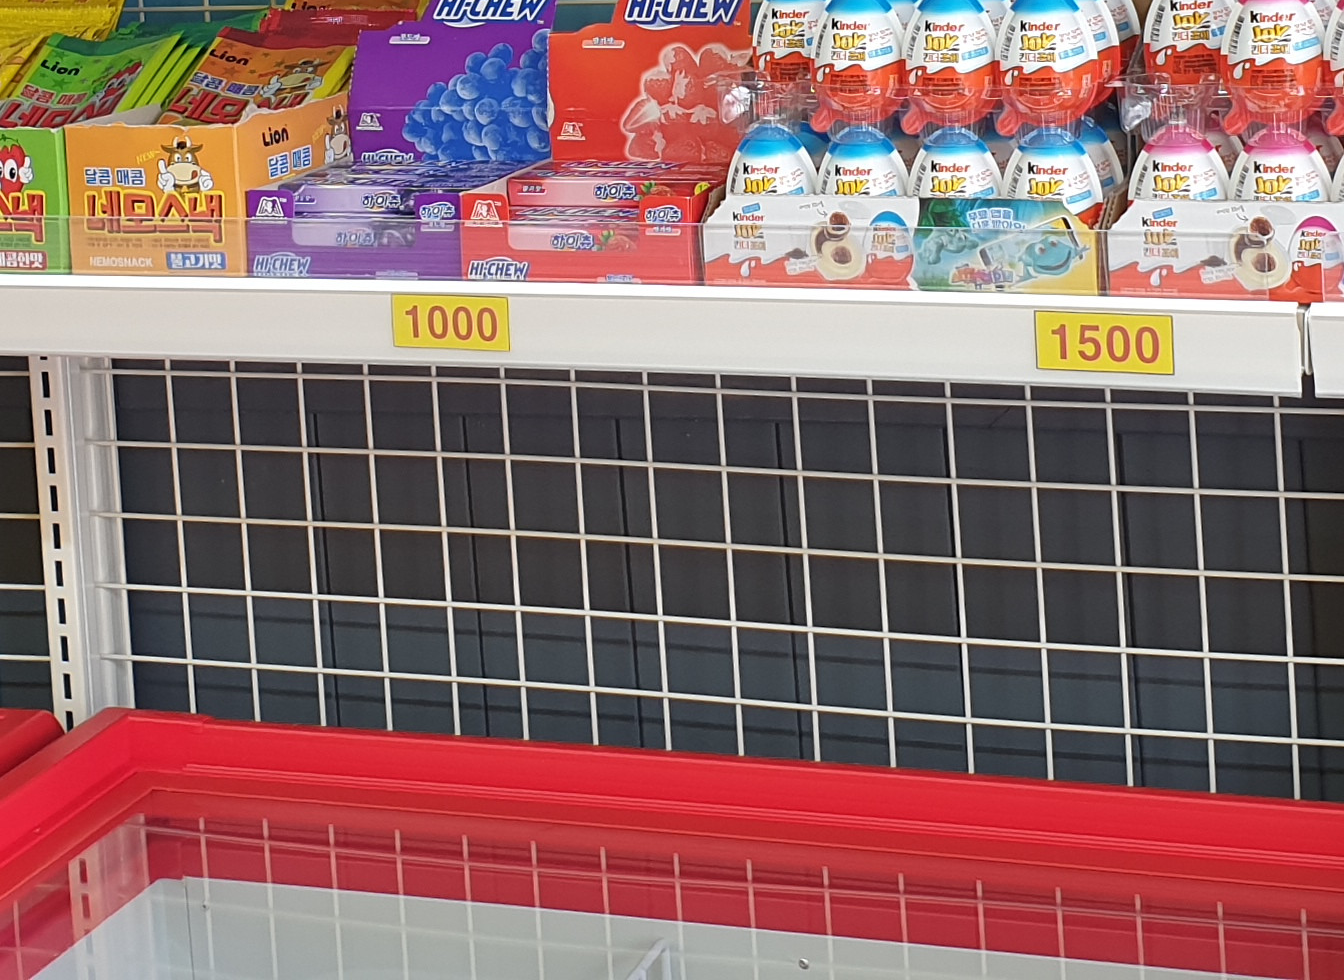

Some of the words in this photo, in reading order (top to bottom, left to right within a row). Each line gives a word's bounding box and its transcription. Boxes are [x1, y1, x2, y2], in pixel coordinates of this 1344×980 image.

[210, 49, 252, 66] Lion
[41, 59, 81, 76] Lion
[262, 126, 289, 147] Lion
[594, 183, 637, 201] 하이츄
[362, 193, 404, 211] 하이츄
[86, 189, 224, 244] 네모스낵
[420, 204, 456, 220] 하이츄
[645, 206, 683, 223] 하이츄
[90, 256, 153, 268] NEMOSNACK
[405, 305, 498, 342] 1000
[1051, 324, 1160, 364] 1500
